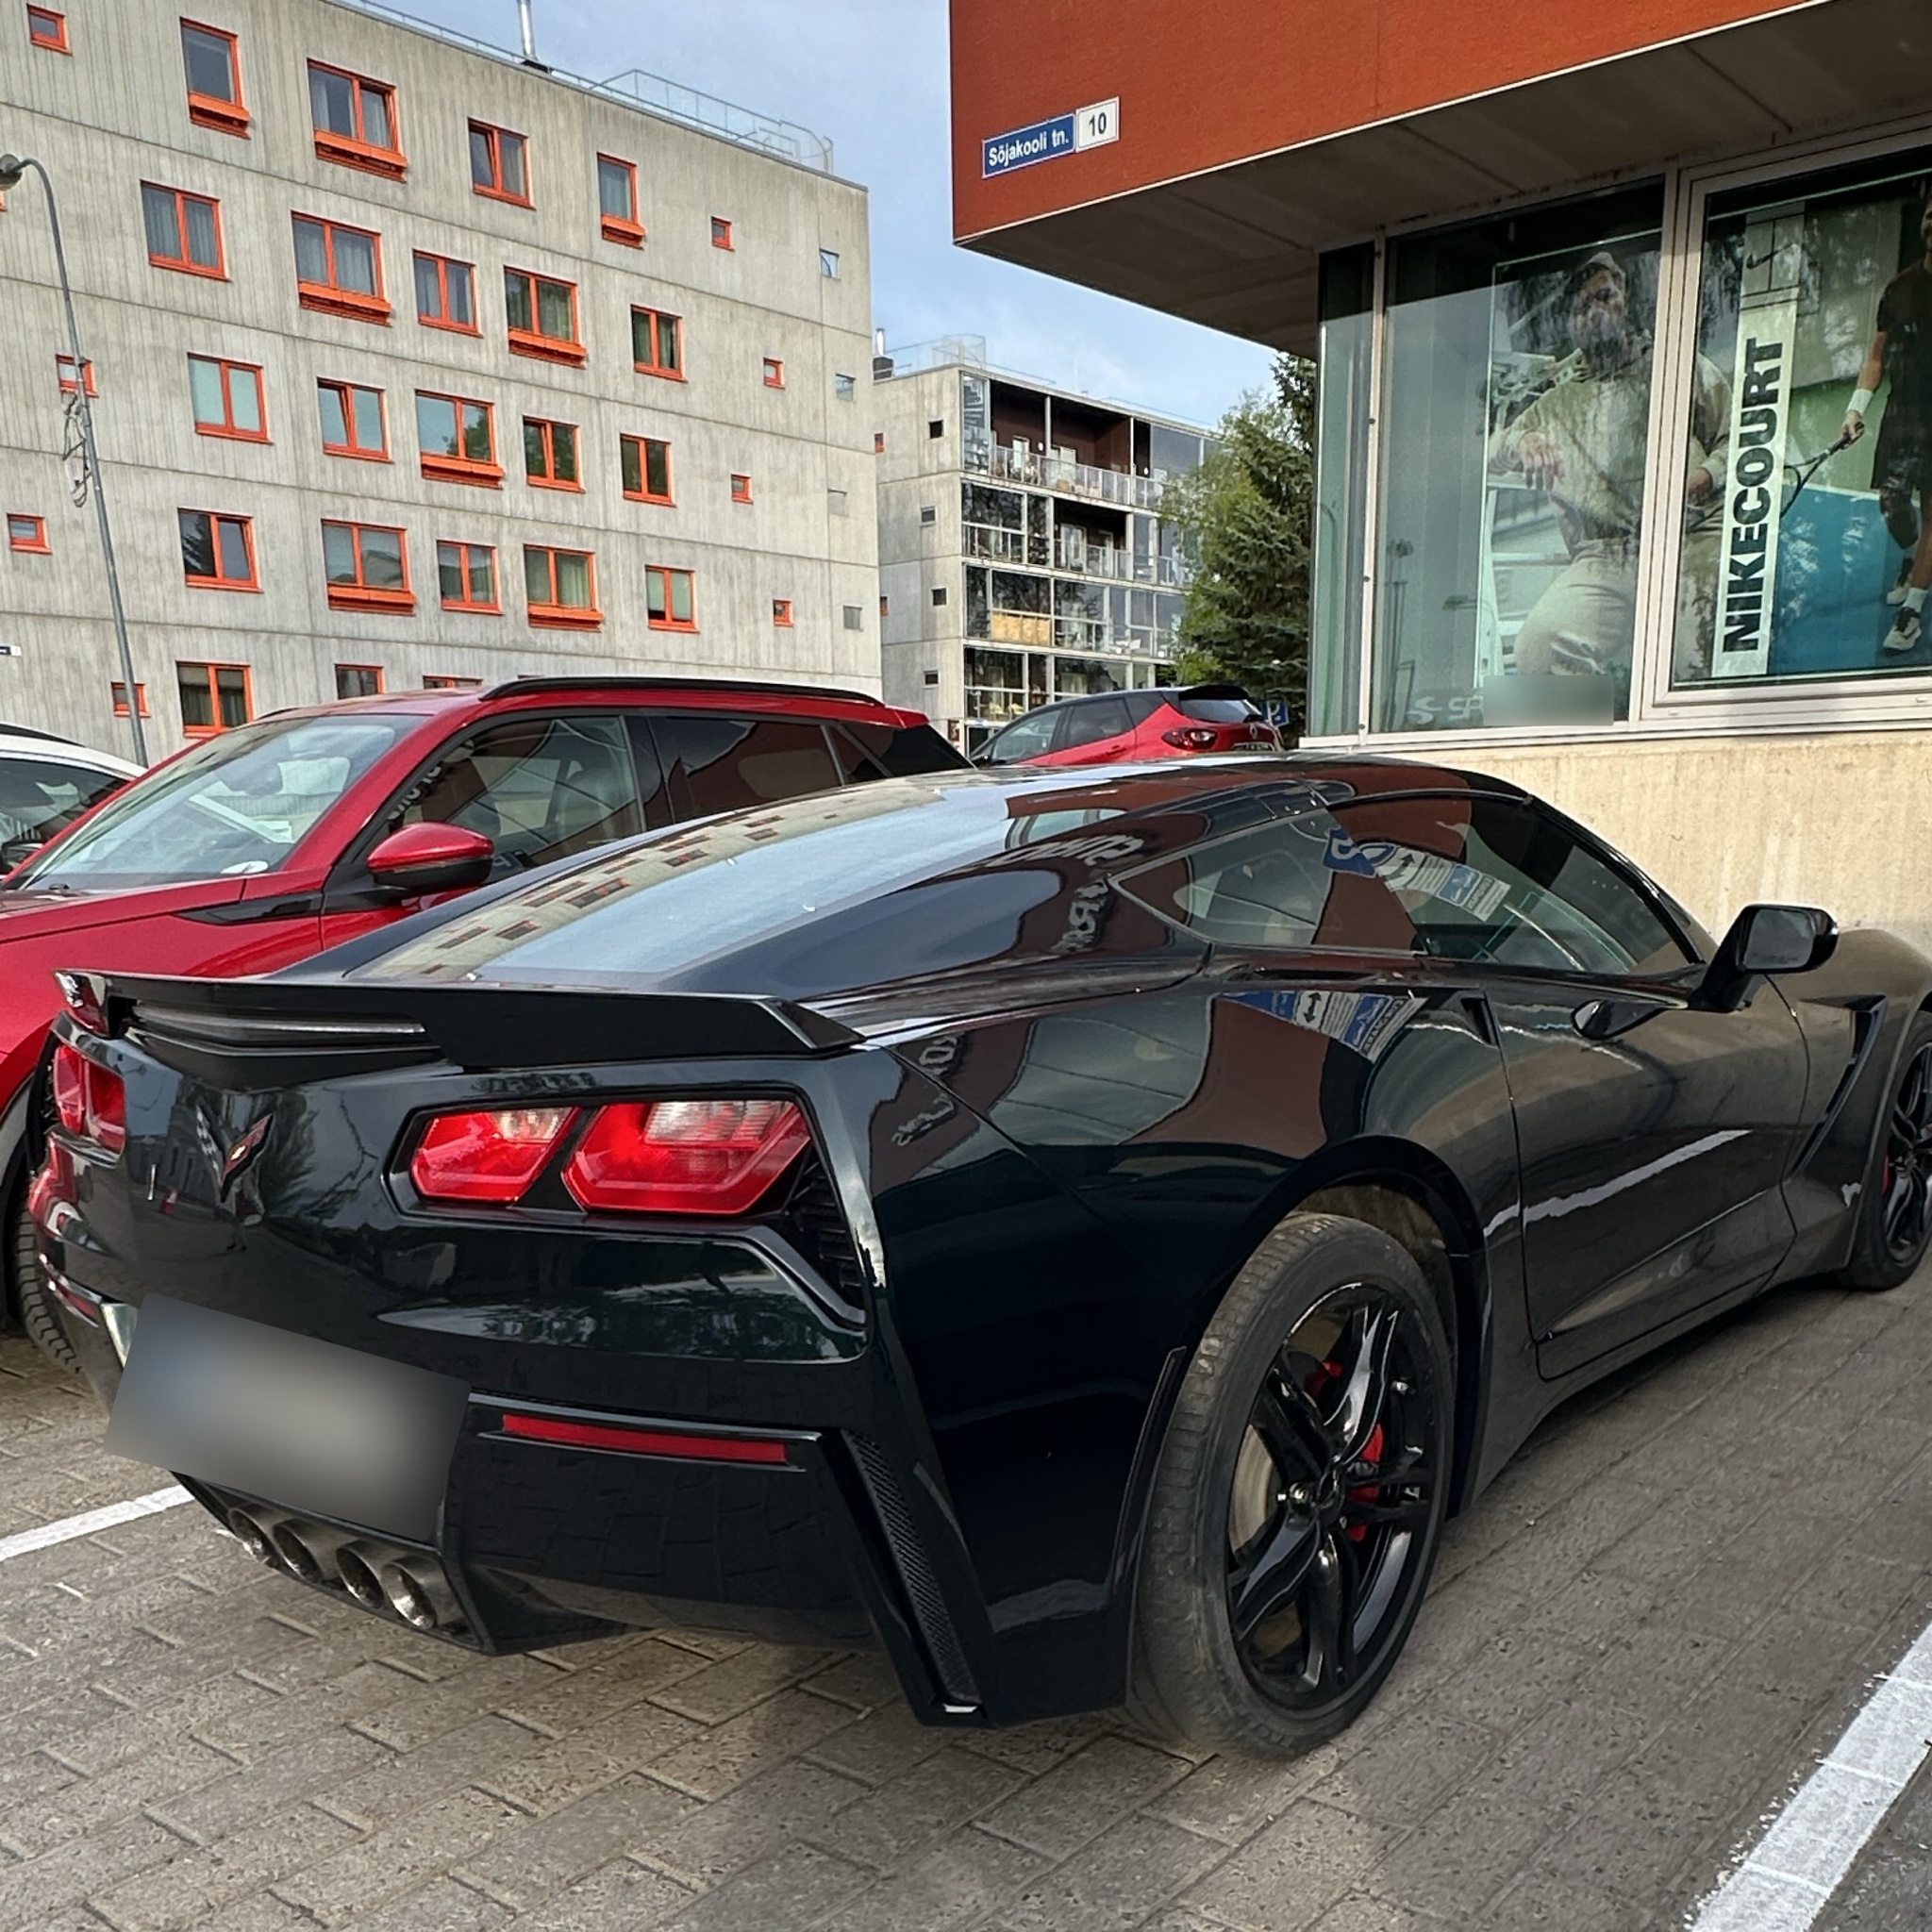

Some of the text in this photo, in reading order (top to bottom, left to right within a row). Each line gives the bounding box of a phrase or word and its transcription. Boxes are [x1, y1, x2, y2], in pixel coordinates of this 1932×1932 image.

[989, 112, 1107, 167] Sõjakooli tn. 10
[1723, 338, 1782, 652] NIKECOURT
